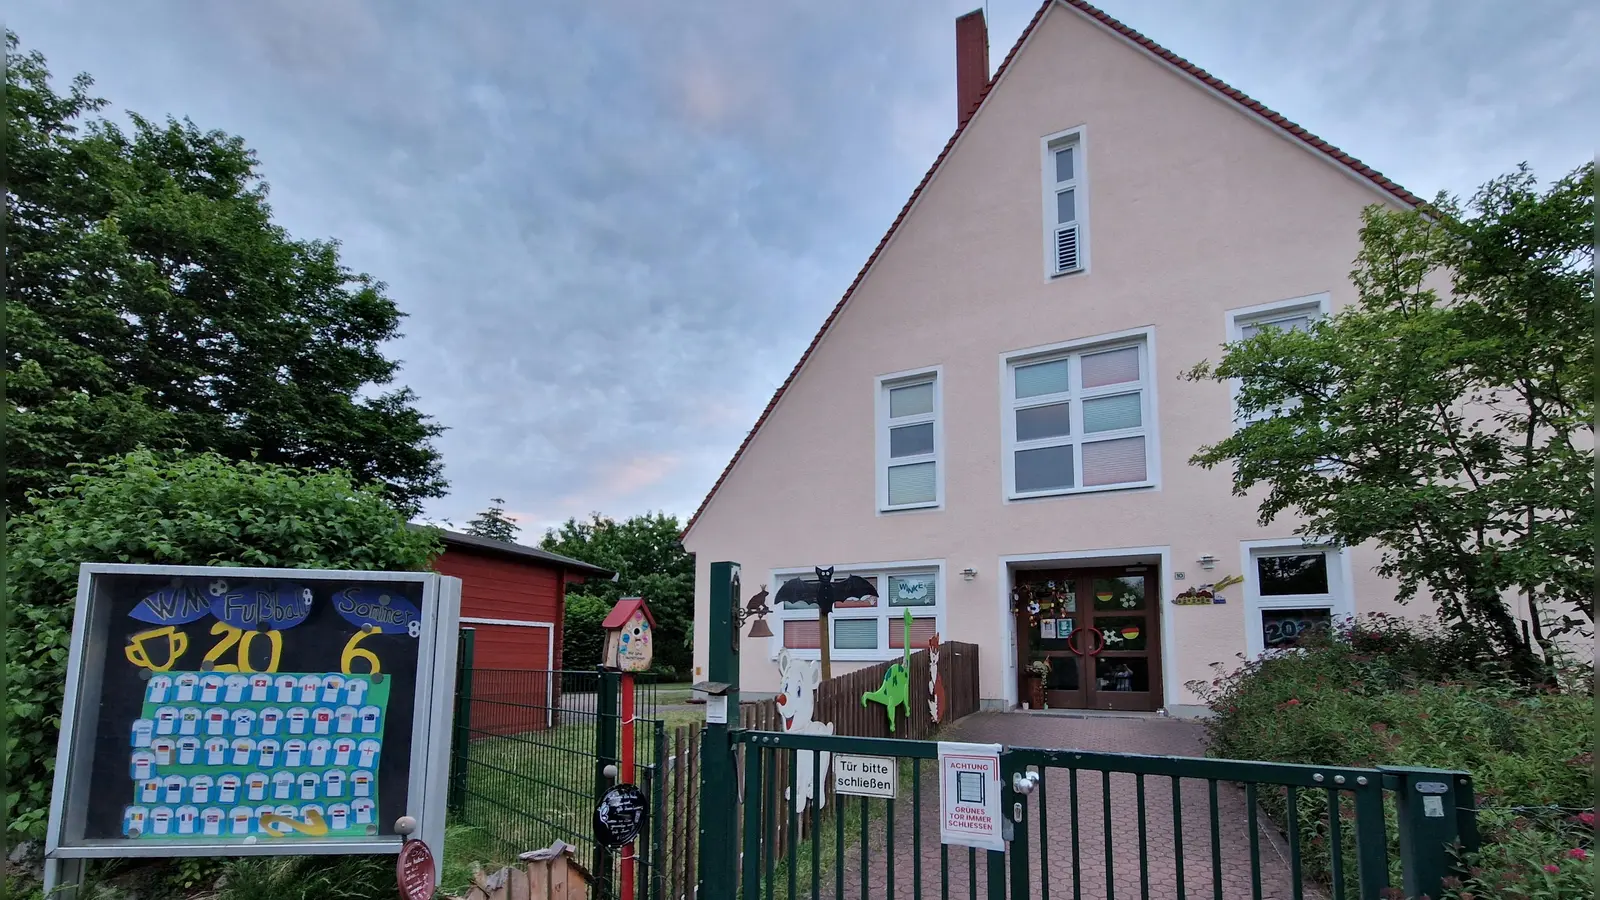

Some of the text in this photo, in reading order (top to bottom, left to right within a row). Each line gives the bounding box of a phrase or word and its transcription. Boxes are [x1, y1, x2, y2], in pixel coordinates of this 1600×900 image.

[143, 585, 210, 621] WM
[339, 586, 414, 628] Sommer
[200, 621, 382, 675] 20 6
[840, 760, 888, 774] Tür bitte
[950, 762, 989, 771] ACHTUNG
[838, 776, 891, 790] schließen
[948, 820, 993, 831] SCHLIESSEN
[966, 814, 992, 823] IMMER
